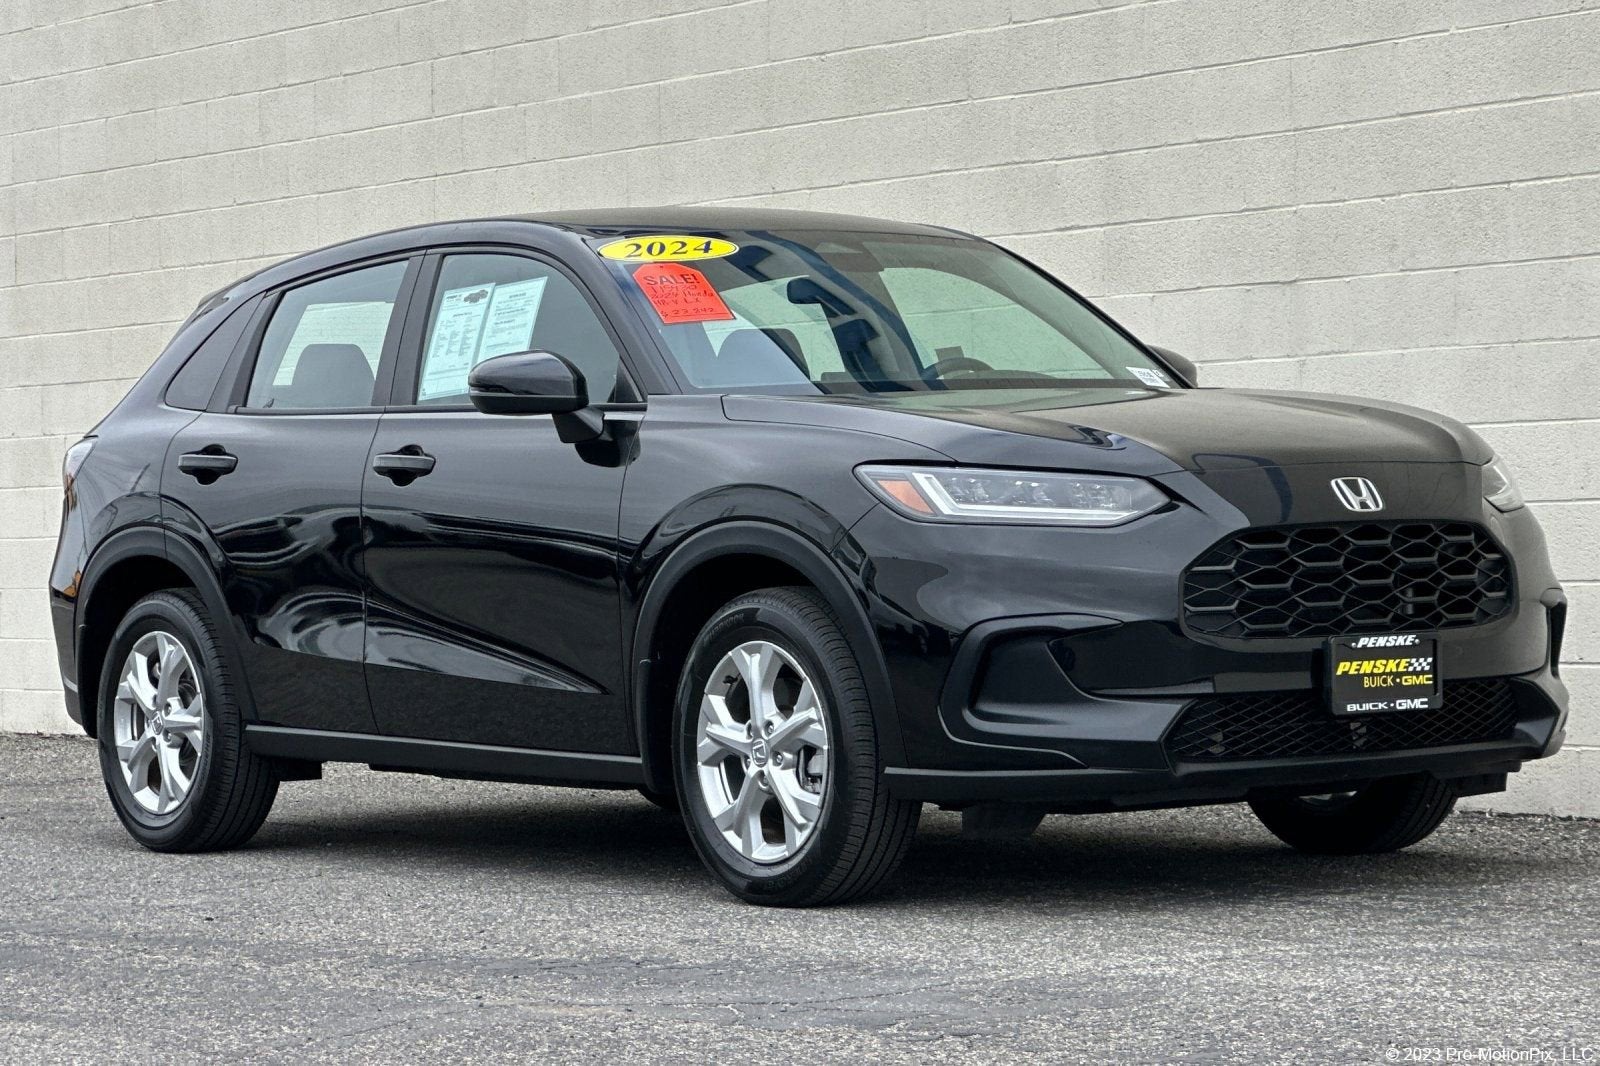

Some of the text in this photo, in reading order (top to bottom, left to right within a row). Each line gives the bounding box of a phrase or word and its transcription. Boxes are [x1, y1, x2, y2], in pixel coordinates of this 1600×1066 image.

[624, 240, 713, 258] 2024
[643, 273, 700, 286] SALE!
[1357, 634, 1417, 648] PENSKE
[1336, 658, 1410, 676] PENSKE
[1363, 674, 1433, 688] BUICK GMC
[1346, 698, 1429, 712] BUICK GMC
